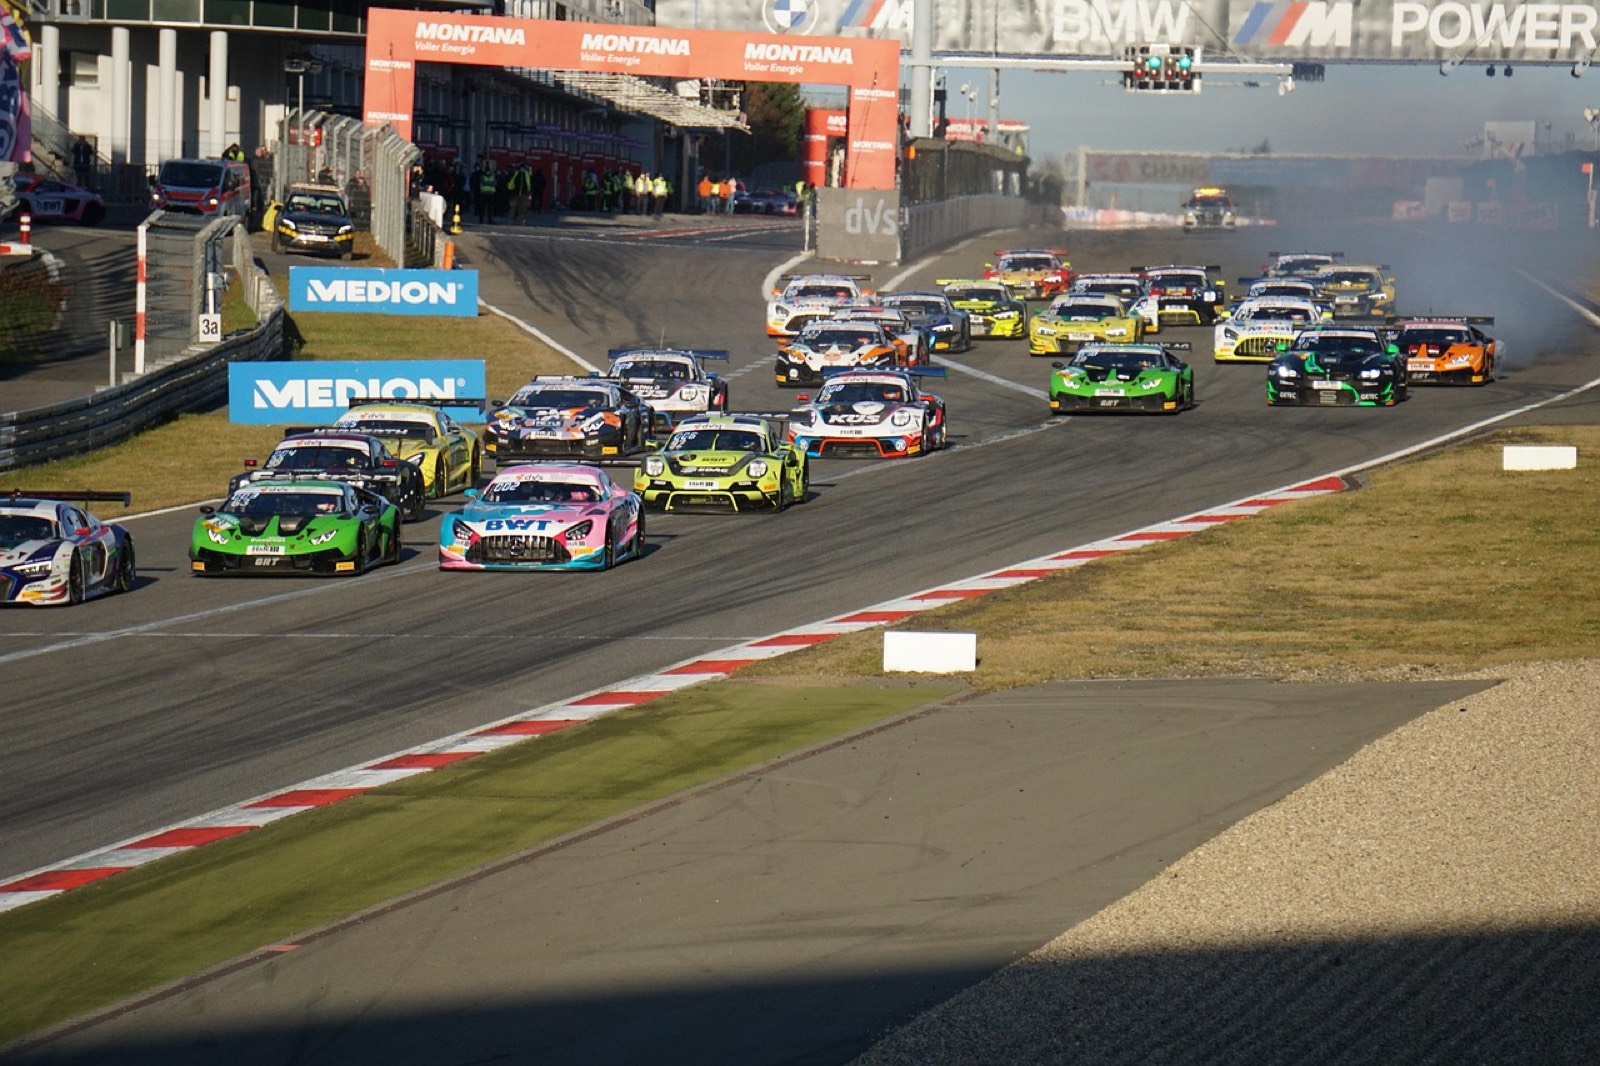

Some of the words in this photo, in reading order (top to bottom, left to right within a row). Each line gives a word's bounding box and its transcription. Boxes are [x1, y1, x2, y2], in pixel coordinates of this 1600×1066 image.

[1053, 0, 1191, 43] BMW
[1391, 2, 1598, 49] POWER
[415, 21, 526, 46] MONTANA
[415, 41, 440, 52] Voller
[441, 42, 476, 56] Energie
[580, 33, 691, 56] MONTANA
[580, 51, 606, 63] Voller
[607, 53, 641, 66] Energie
[744, 42, 854, 65] MONTANA
[369, 59, 411, 69] MONTANA
[743, 61, 769, 72] Voller
[770, 63, 804, 75] Energie
[854, 88, 895, 98] MONTANA
[367, 111, 409, 121] MONTANA
[307, 279, 457, 304] MEDION
[201, 318, 219, 335] 3a
[254, 378, 456, 408] MEDION
[485, 519, 552, 532] BWT
